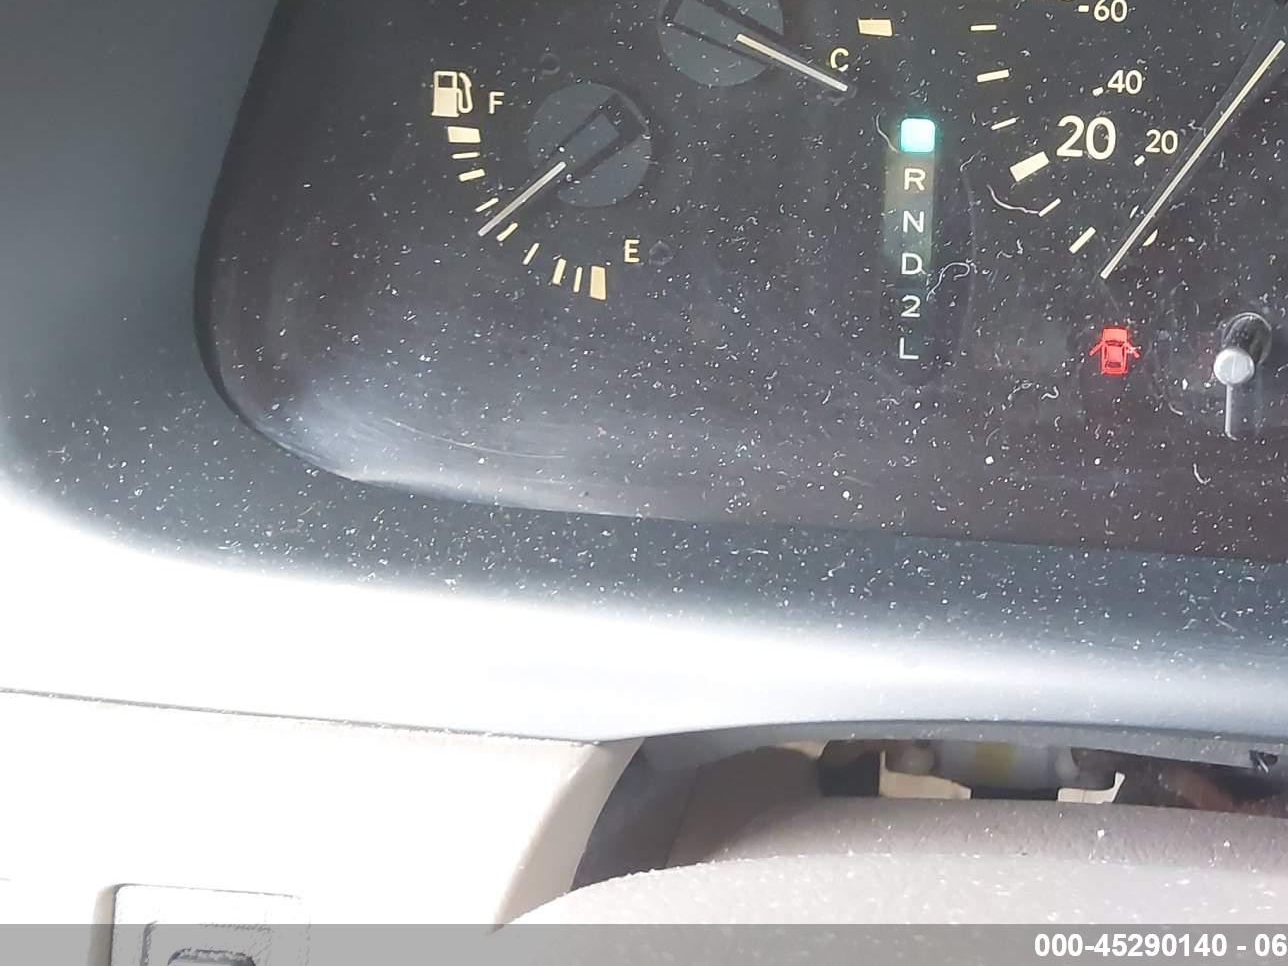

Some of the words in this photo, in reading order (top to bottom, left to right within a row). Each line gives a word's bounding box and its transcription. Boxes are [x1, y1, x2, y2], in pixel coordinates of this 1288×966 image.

[830, 48, 849, 72] C
[1108, 70, 1142, 95] 40
[489, 92, 504, 114] F
[1057, 116, 1116, 159] 20
[1145, 130, 1177, 154] 20
[903, 168, 926, 191] R
[903, 211, 924, 233] N
[625, 240, 640, 263] E
[901, 253, 923, 275] D
[901, 295, 921, 318] 2
[900, 337, 919, 359] L
